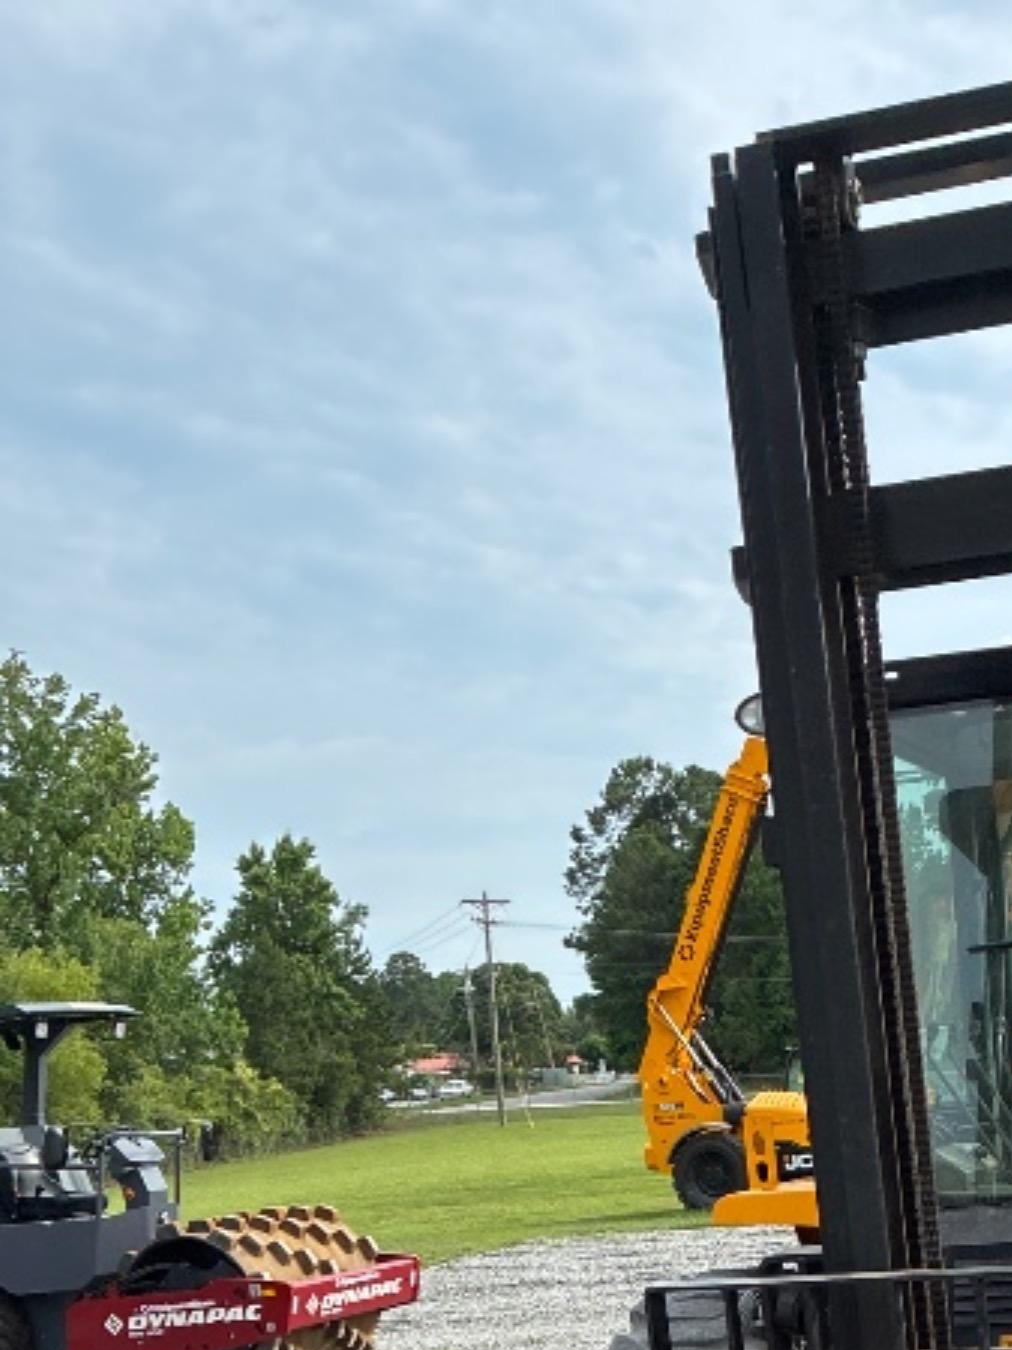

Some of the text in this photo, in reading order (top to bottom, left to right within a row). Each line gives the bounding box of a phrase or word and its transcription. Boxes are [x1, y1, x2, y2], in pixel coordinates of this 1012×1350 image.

[783, 1154, 814, 1171] JC
[320, 1277, 403, 1309] DYNAPAC
[128, 1304, 261, 1331] DYNAPAC
